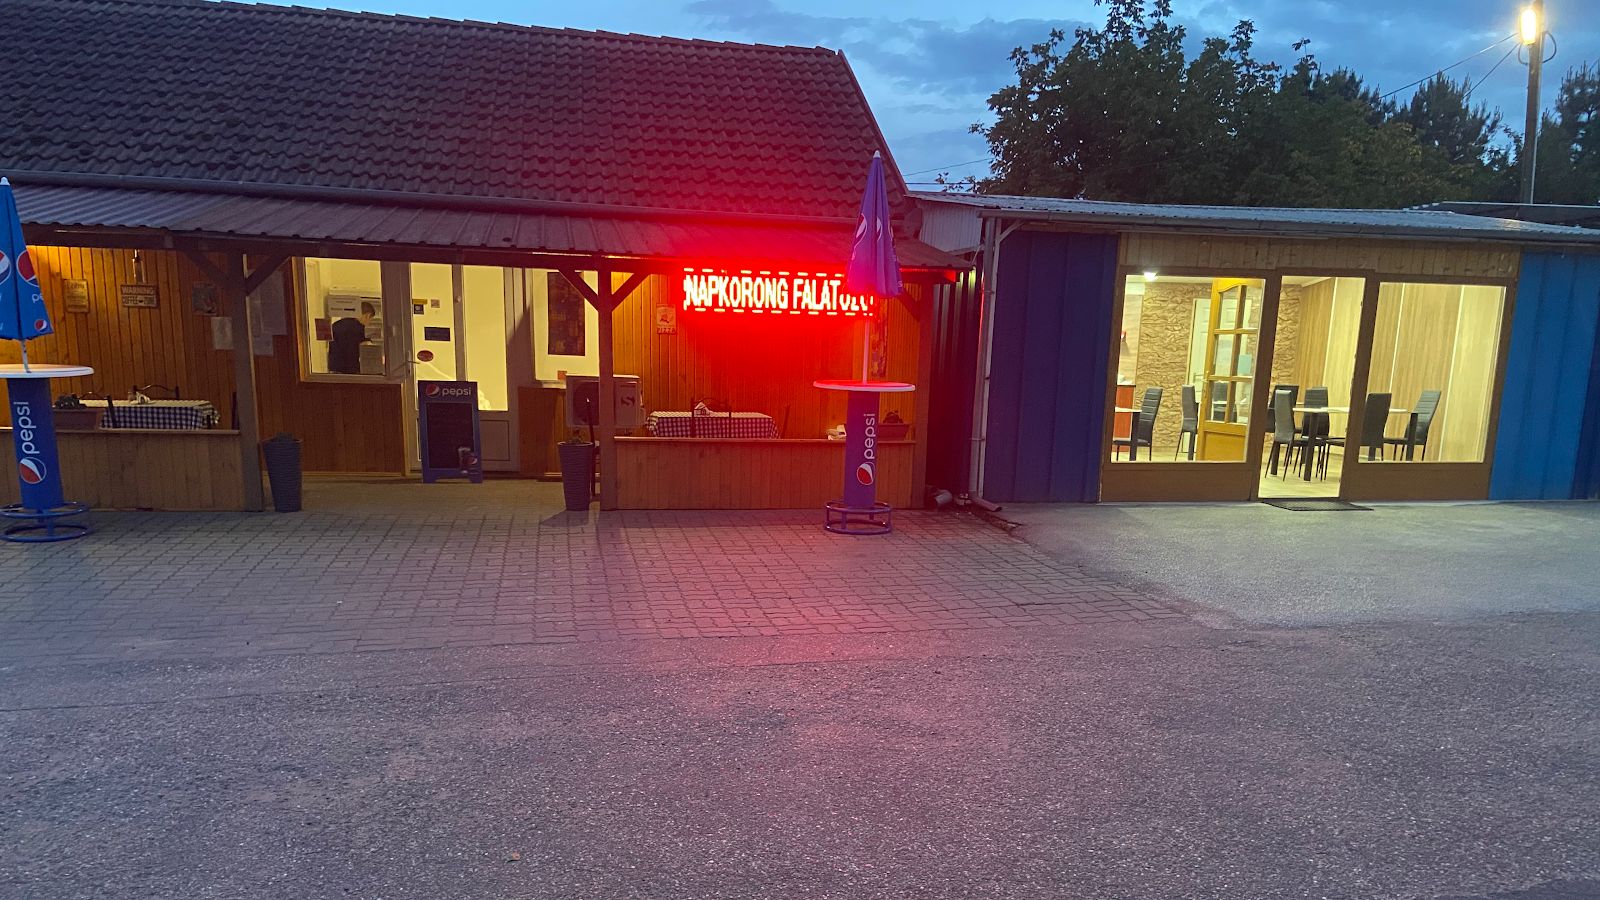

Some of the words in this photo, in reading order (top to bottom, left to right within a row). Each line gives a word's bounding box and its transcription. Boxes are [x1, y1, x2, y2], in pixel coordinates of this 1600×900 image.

[685, 275, 788, 309] NAPKORONG
[441, 386, 472, 397] pepsi
[13, 401, 40, 454] pepsi
[863, 413, 876, 459] pepsi
